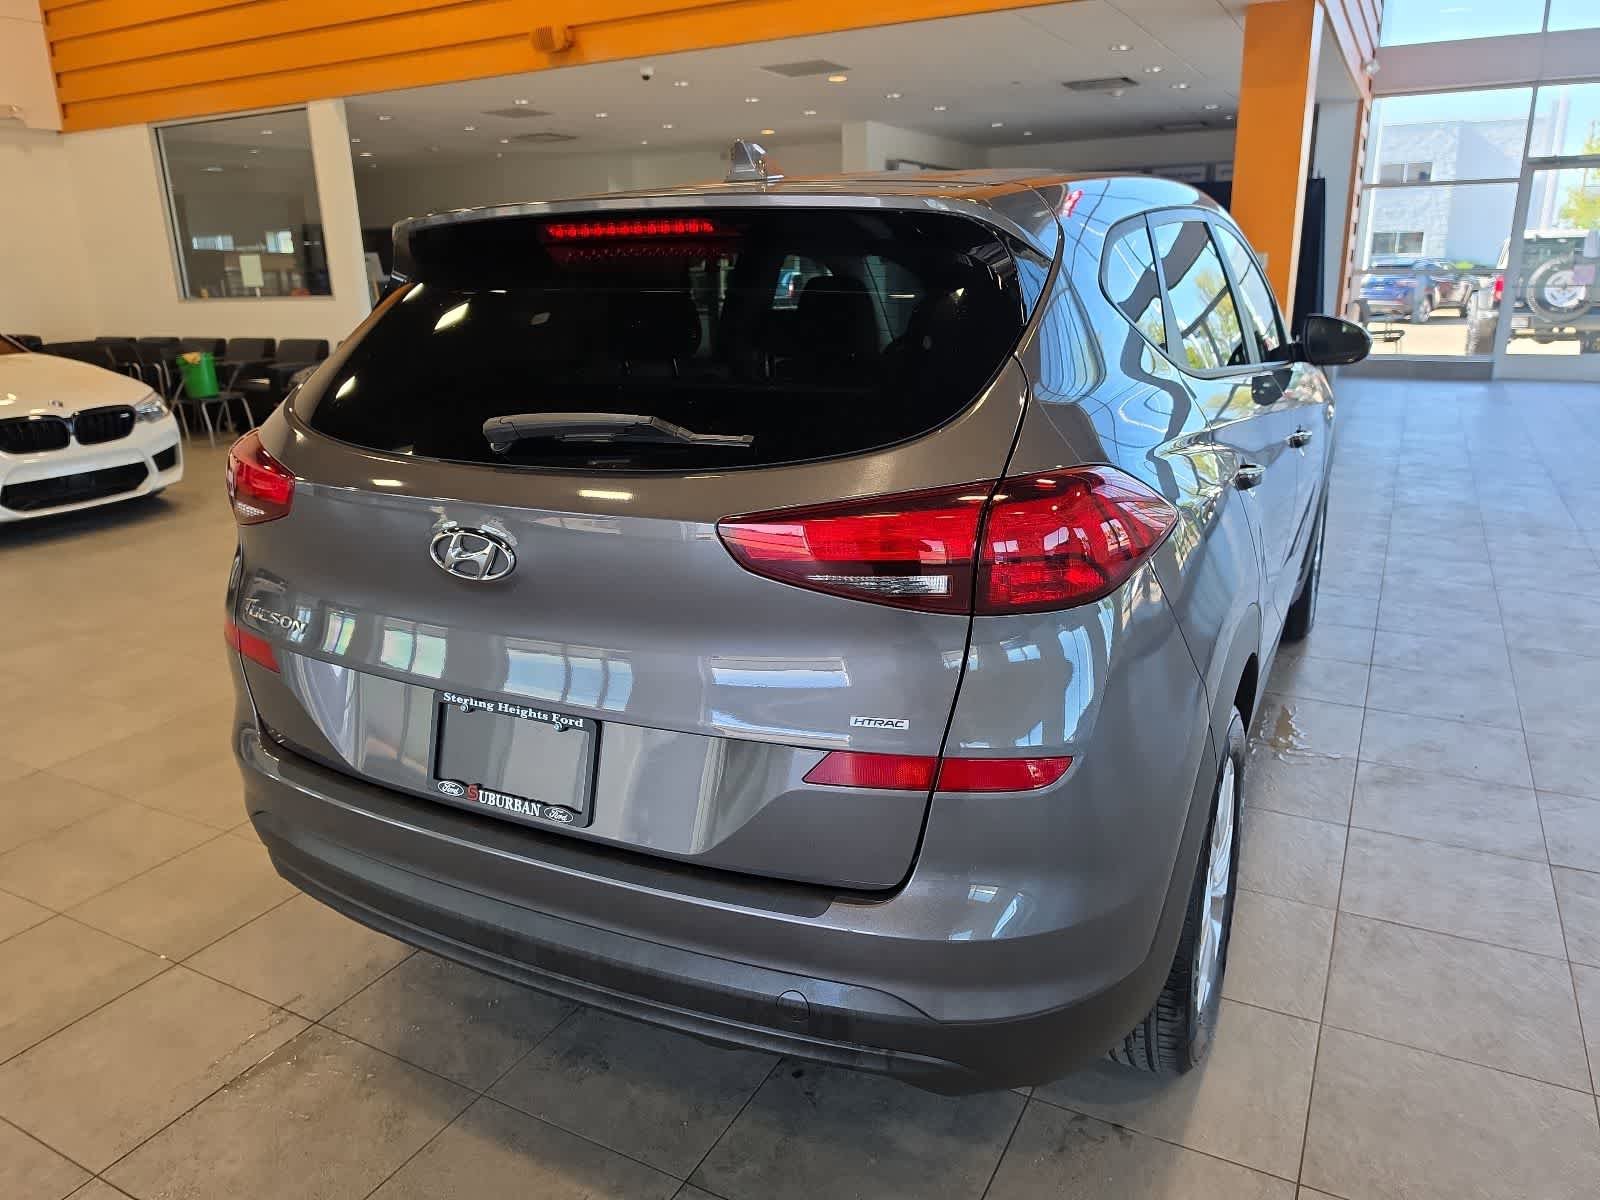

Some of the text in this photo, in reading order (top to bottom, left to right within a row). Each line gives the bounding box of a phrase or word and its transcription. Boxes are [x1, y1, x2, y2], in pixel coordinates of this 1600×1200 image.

[443, 692, 584, 727] Sterling Heights Ford
[854, 718, 905, 728] HTRAC
[467, 784, 541, 816] SUBURBAN
